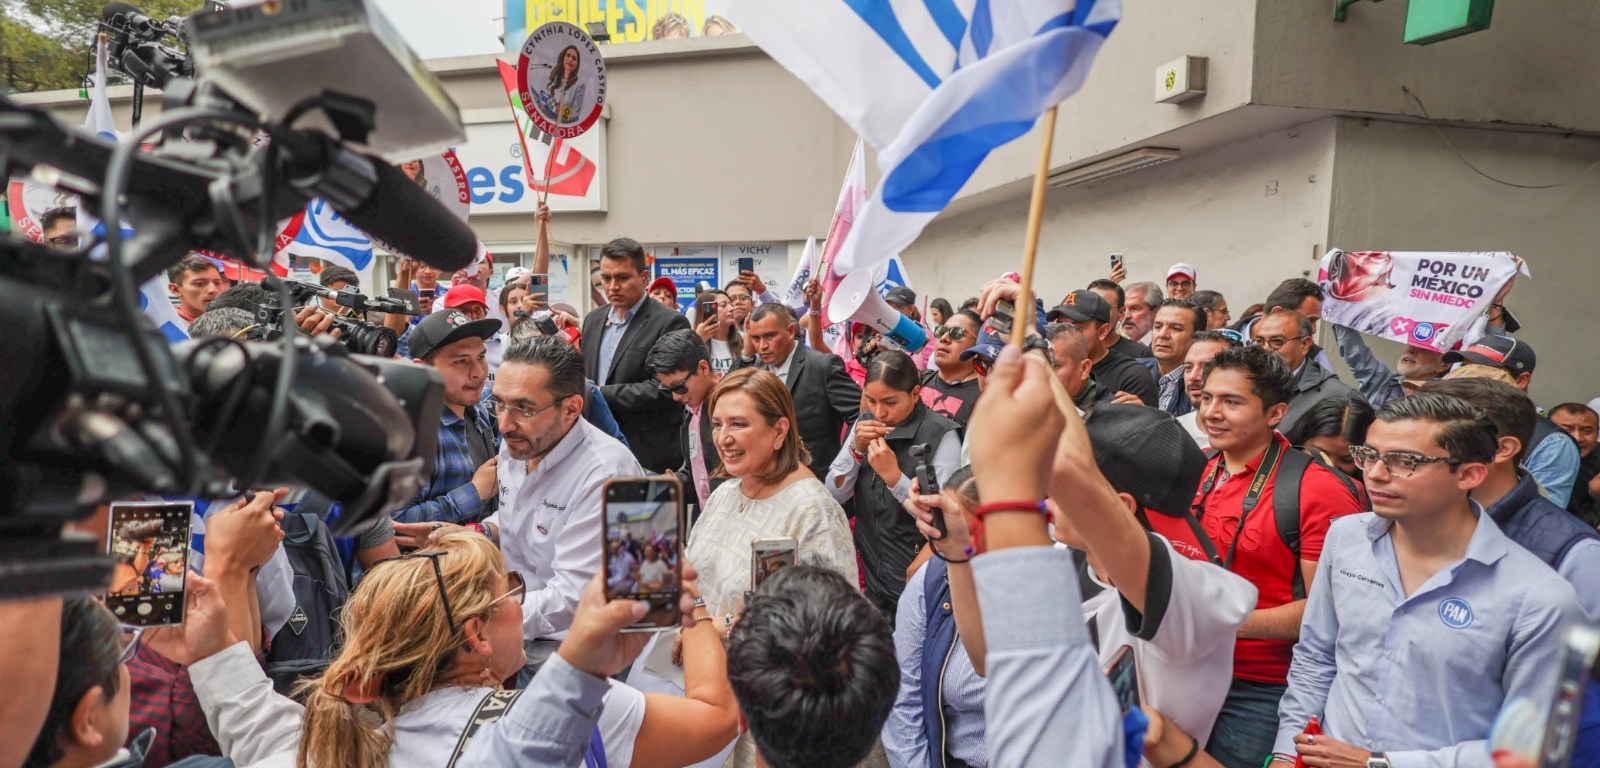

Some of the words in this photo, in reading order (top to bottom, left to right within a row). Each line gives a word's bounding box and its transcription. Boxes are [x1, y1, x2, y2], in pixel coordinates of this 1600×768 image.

[525, 25, 564, 55] CYNTHIA
[568, 27, 596, 55] LÓPEZ
[595, 58, 605, 104] CASTRO
[521, 92, 584, 138] SENADORA
[444, 151, 468, 201] ASTRO
[739, 246, 771, 255] VICHY
[671, 266, 687, 275] MÁS
[1417, 258, 1457, 277] POR
[1461, 265, 1490, 282] UN
[1409, 288, 1431, 301] SIN
[1411, 274, 1483, 298] MÉXICO
[1062, 292, 1077, 305] A
[1415, 326, 1431, 337] PAN
[1252, 473, 1266, 494] Nikon
[1443, 602, 1468, 623] PAN
